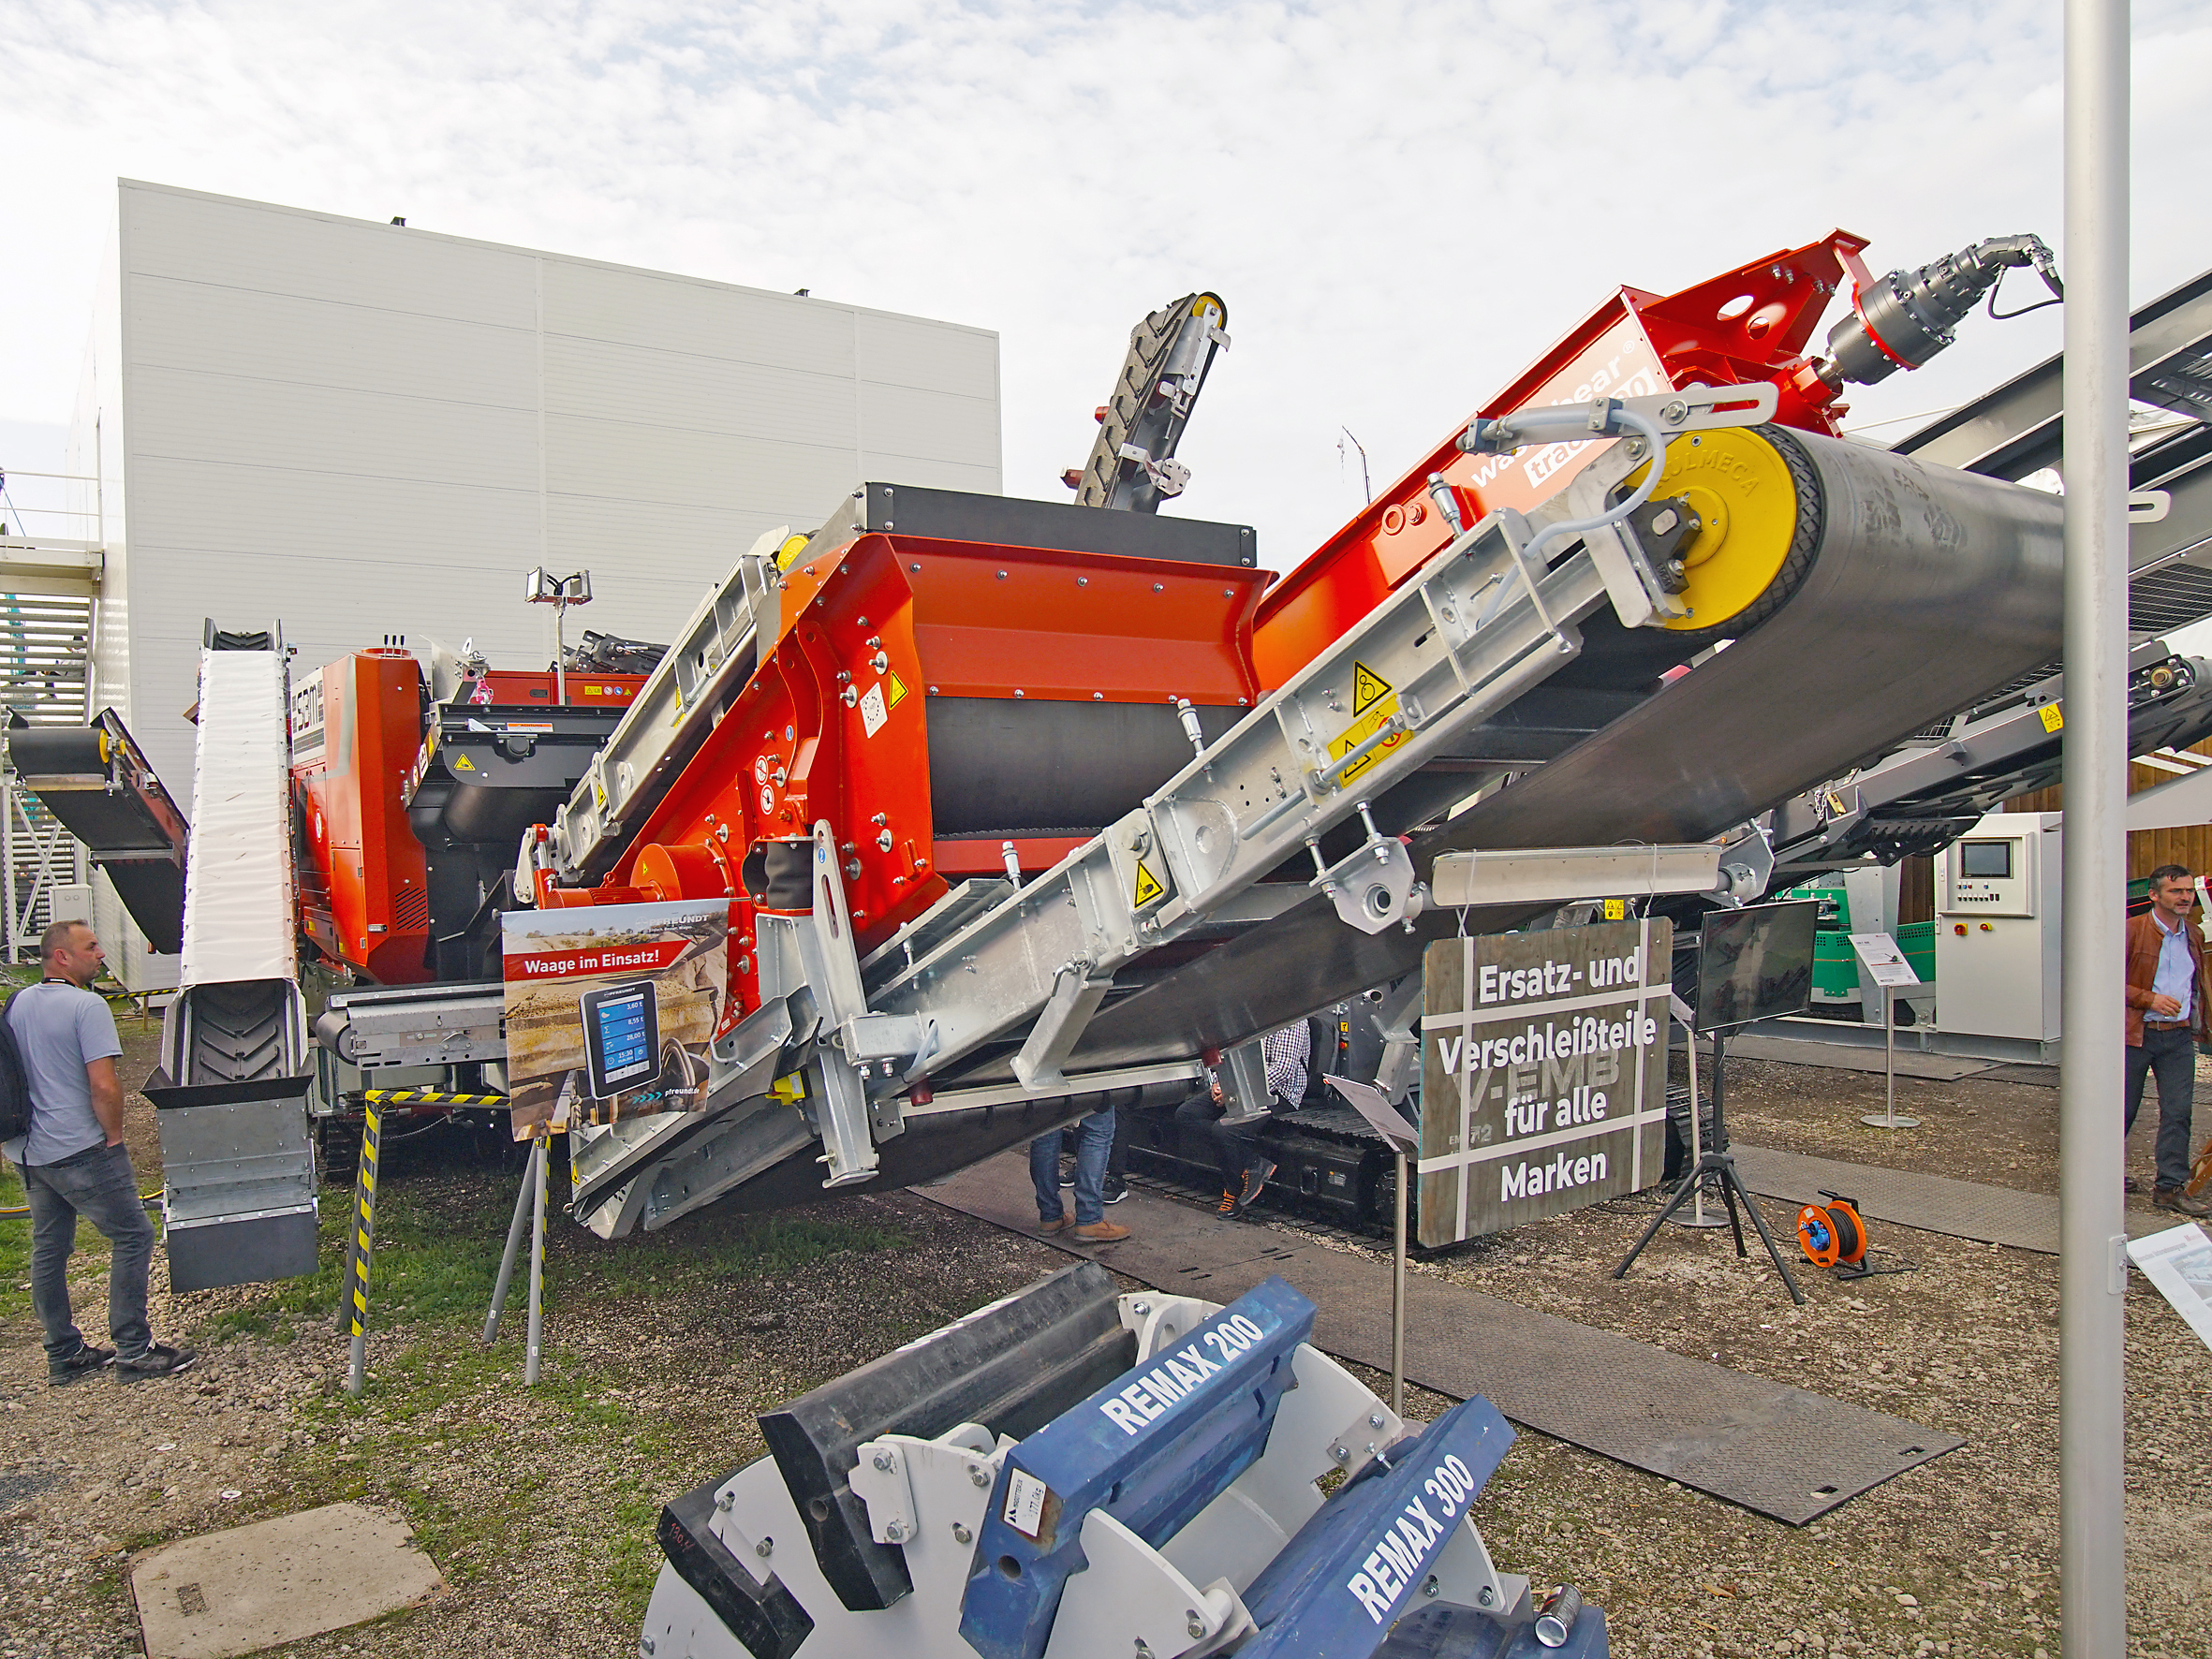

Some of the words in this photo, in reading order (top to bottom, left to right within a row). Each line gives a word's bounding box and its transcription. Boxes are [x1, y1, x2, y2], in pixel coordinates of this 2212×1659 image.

[524, 958, 576, 974] Waage
[580, 955, 598, 969] im
[602, 948, 659, 968] Einsatz!
[1480, 960, 1583, 1004] Ersatz-
[1589, 946, 1640, 989] und
[1438, 1008, 1656, 1075] Verschleißteile
[1504, 1094, 1548, 1138] für
[1555, 1085, 1607, 1127] alle
[1500, 1152, 1607, 1202] Marken
[1099, 1343, 1222, 1436] REMAX
[1202, 1313, 1264, 1363] 200
[1347, 1494, 1444, 1624] REMAX
[1424, 1453, 1476, 1518] 300
